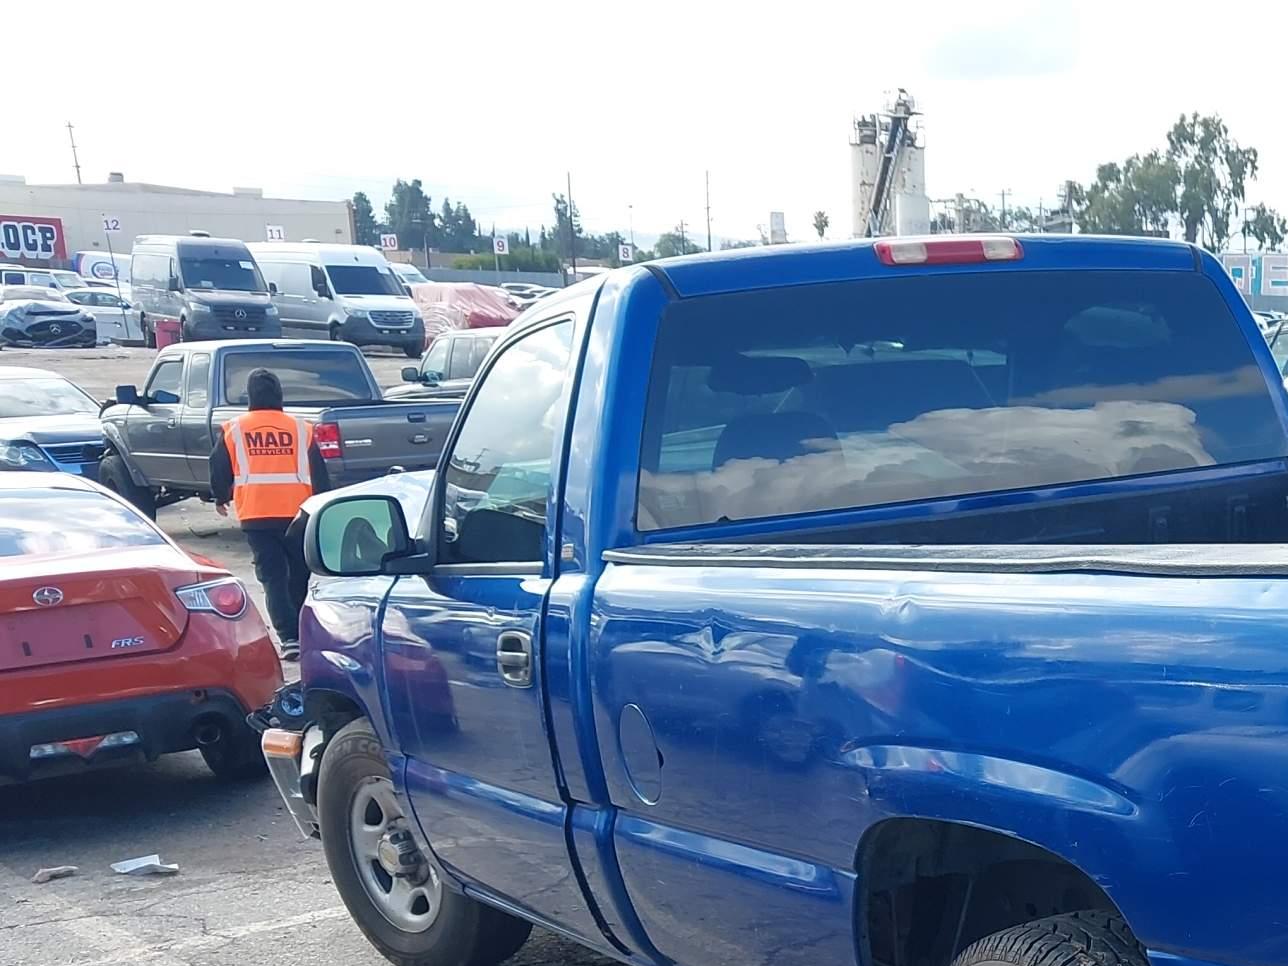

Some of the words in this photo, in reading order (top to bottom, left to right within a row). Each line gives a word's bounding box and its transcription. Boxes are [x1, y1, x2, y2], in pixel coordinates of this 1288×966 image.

[104, 219, 120, 231] 12
[0, 224, 55, 253] OCP
[268, 229, 283, 240] 11
[383, 237, 397, 248] 10
[496, 240, 505, 252] 9
[622, 247, 630, 259] 8
[244, 431, 293, 448] MAD
[249, 448, 292, 456] SERVICES
